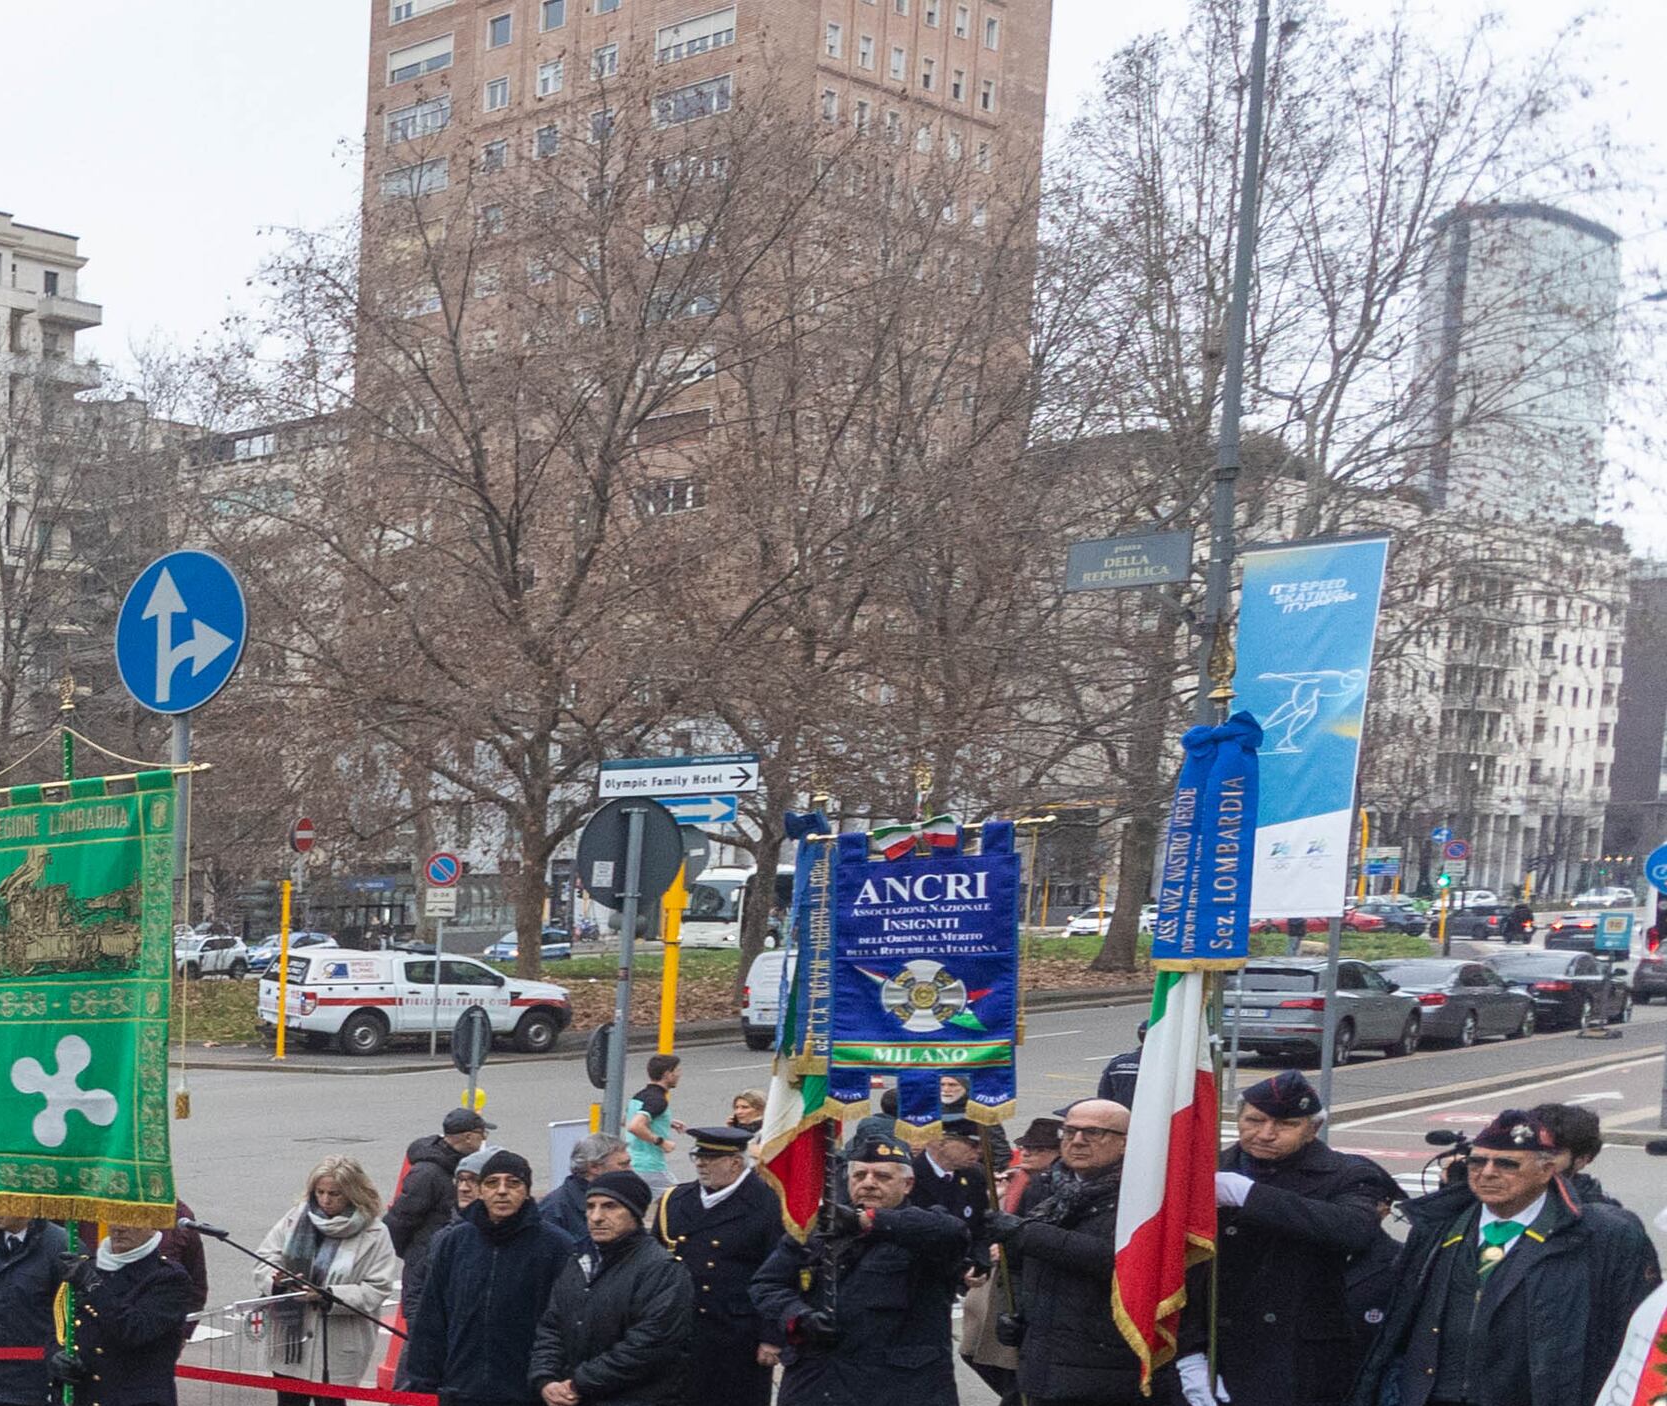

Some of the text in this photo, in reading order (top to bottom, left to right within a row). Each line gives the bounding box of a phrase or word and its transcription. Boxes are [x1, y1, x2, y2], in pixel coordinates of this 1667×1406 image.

[1103, 555, 1149, 568] DELLA
[1082, 565, 1170, 583] REPUBBLICA
[1299, 578, 1348, 592] SPEED
[604, 773, 723, 790] Olympic Family Hotel
[1173, 786, 1198, 830] VERDE
[49, 805, 130, 836] LOMBARDIA
[1166, 830, 1192, 882] NASTRO
[1210, 776, 1245, 950] Sez. LOMBARDIA
[853, 871, 990, 906] ANCRI
[873, 1047, 969, 1063] MILANO
